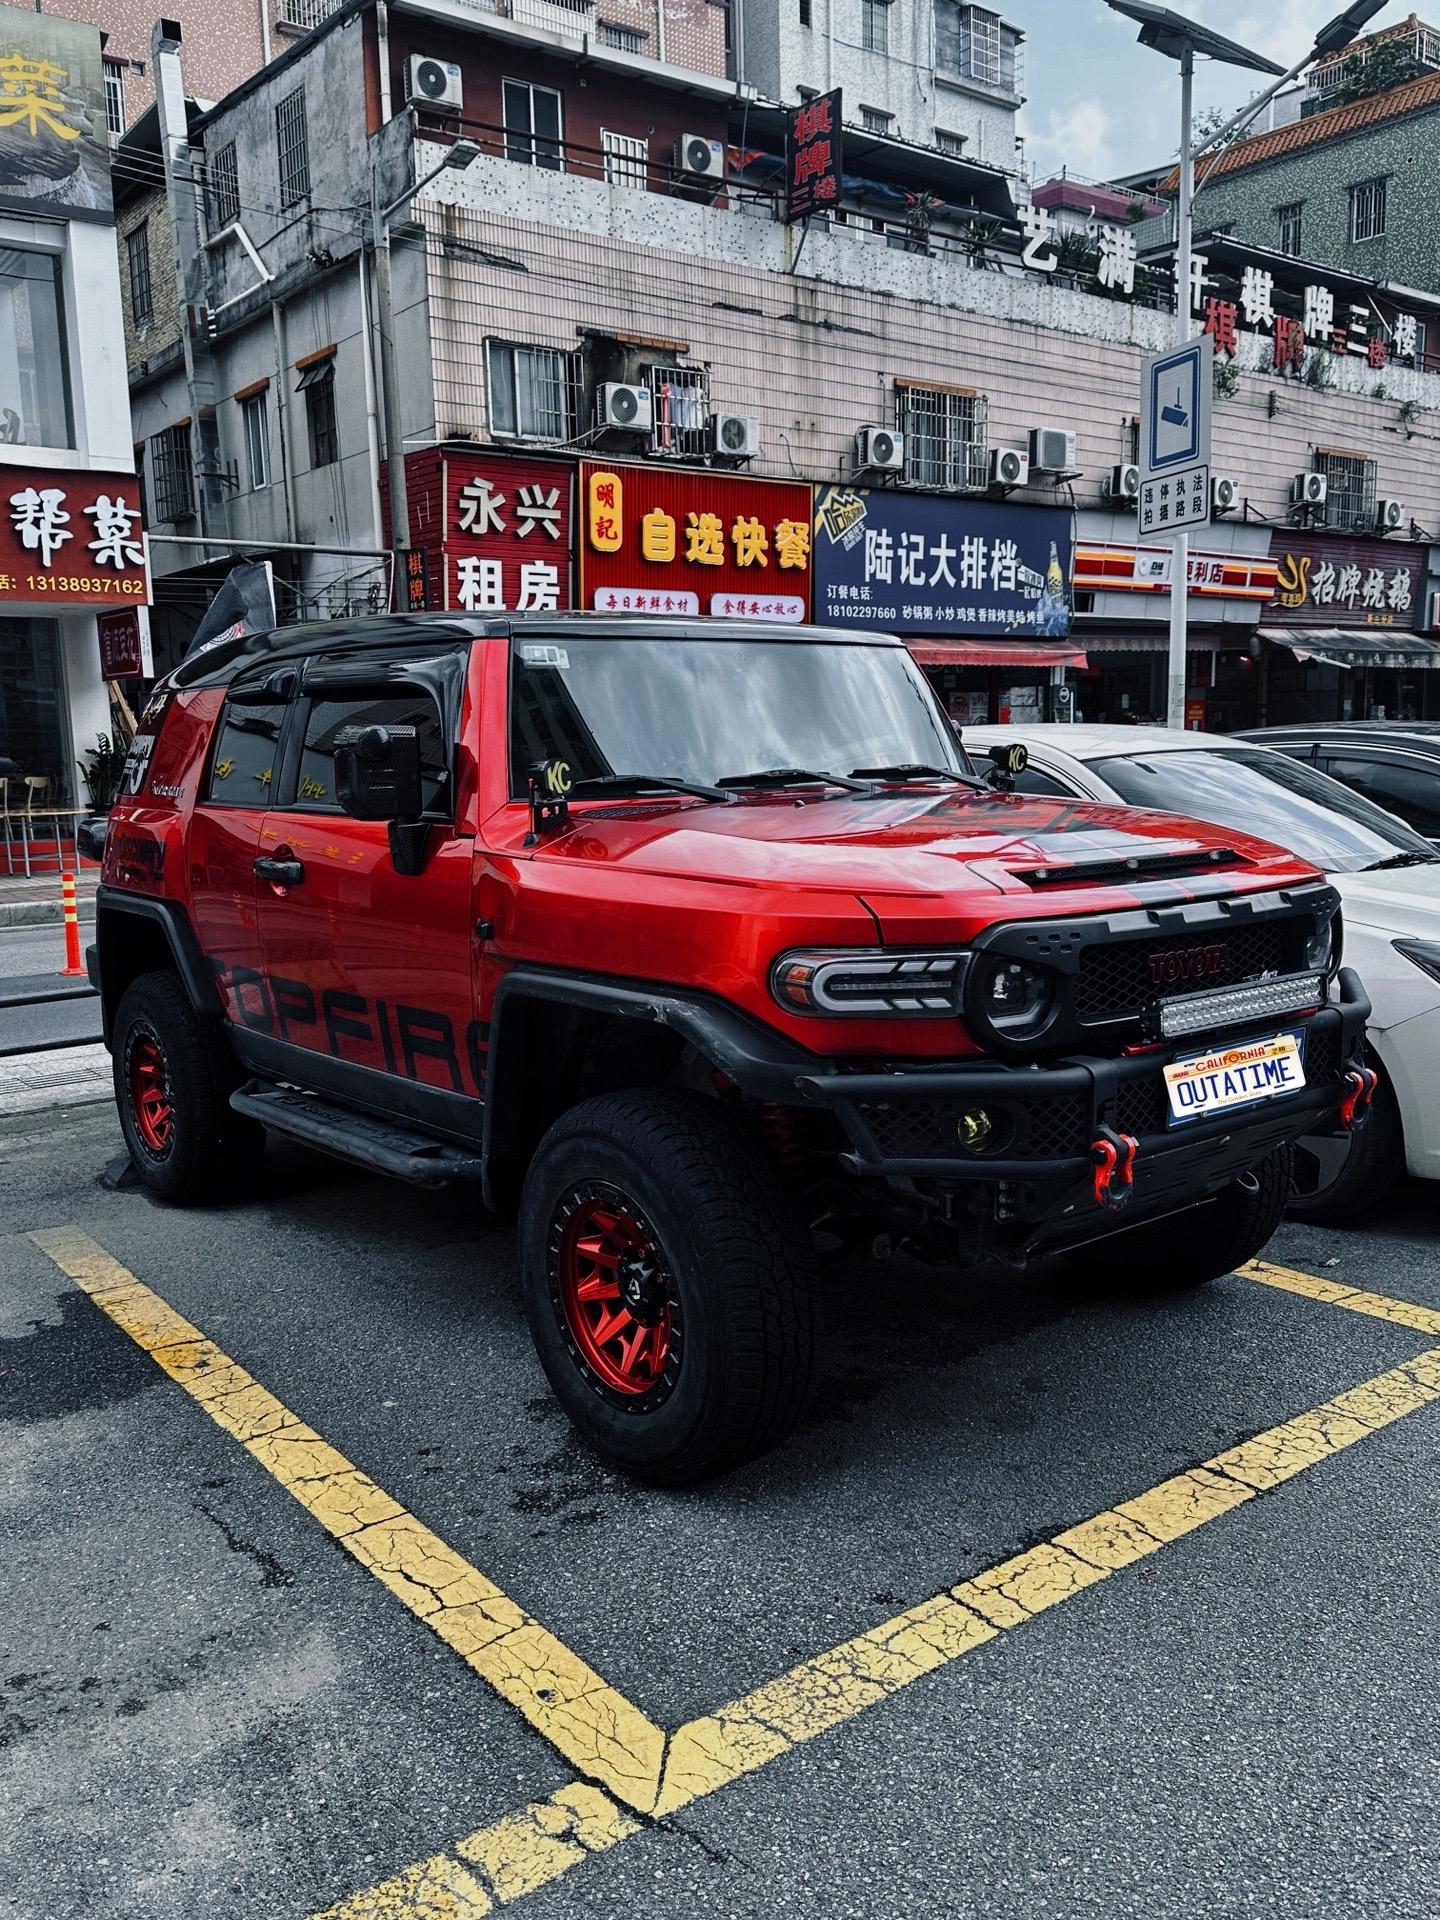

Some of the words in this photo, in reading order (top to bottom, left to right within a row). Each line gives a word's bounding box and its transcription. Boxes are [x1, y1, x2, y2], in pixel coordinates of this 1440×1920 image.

[0, 52, 81, 141] 菜
[793, 98, 833, 185] 棋牌
[789, 174, 837, 214] 三楼
[457, 476, 562, 540] 永兴
[1144, 474, 1203, 504] 违停执法
[9, 487, 146, 569] 帮菜
[1144, 497, 1203, 526] 拍摄路段
[642, 507, 810, 571] 自选快餐
[864, 529, 1017, 591] 陆记大排档
[26, 575, 143, 594] 13138937162
[457, 555, 560, 611] 租房
[605, 595, 689, 611] 每日新鲜食材
[1310, 561, 1412, 612] 招牌烧鹅
[723, 599, 798, 616] 食得安心放心
[827, 605, 896, 619] 18102297660
[547, 761, 572, 794] KC
[1008, 746, 1026, 772] KC
[1148, 944, 1231, 984] TOYOTA
[1195, 1047, 1266, 1072] CALIFORNIA
[1177, 1056, 1295, 1107] OUTATIME
